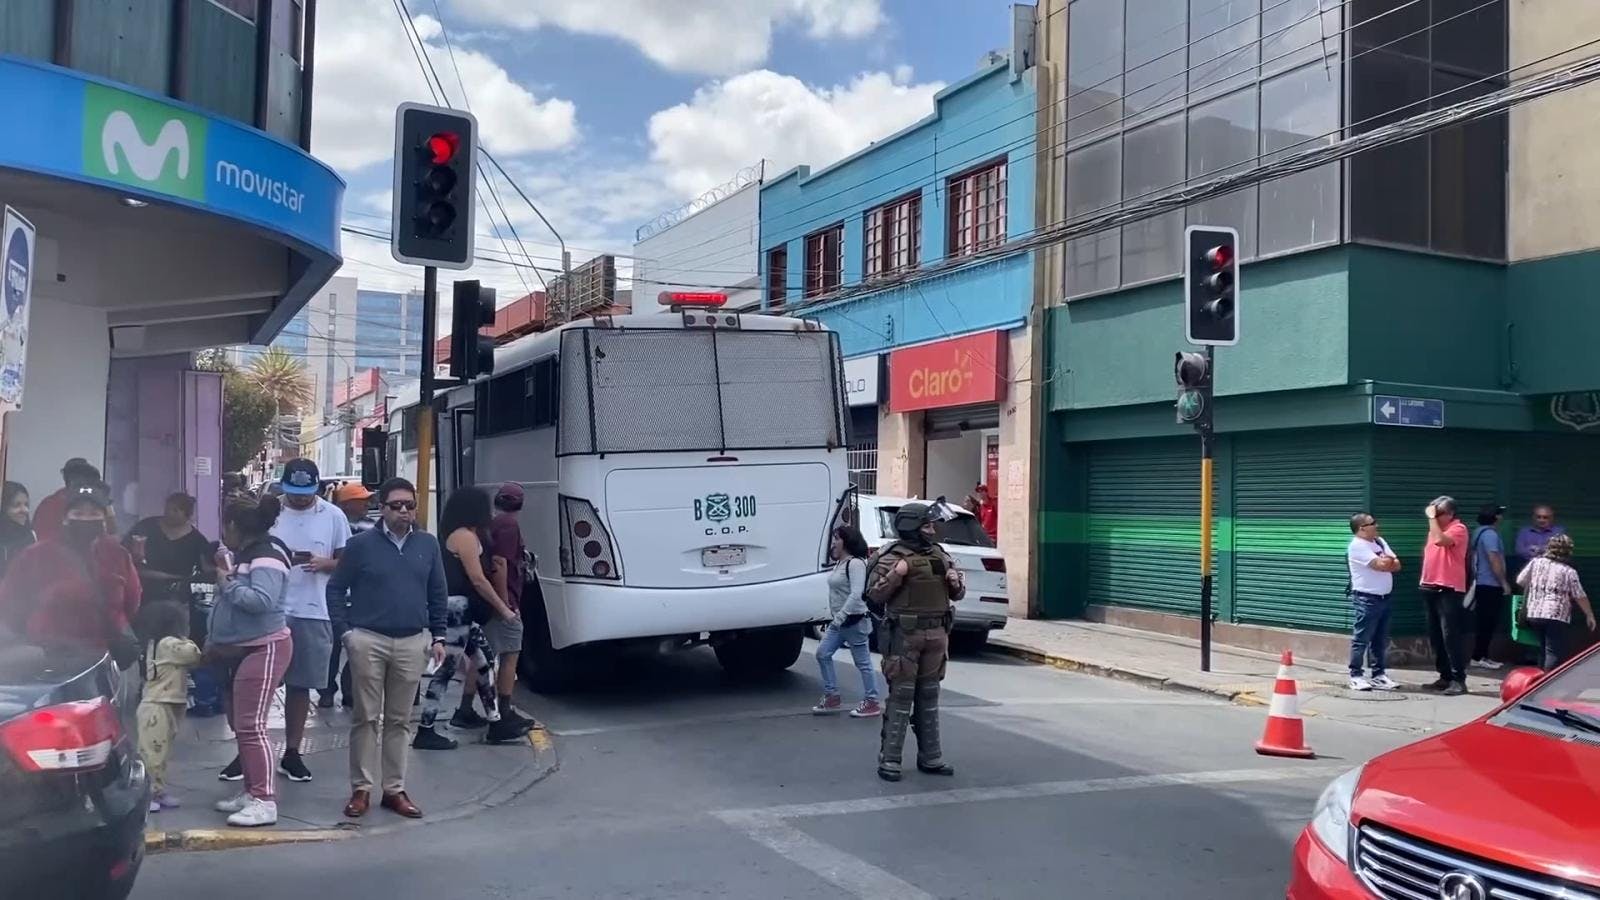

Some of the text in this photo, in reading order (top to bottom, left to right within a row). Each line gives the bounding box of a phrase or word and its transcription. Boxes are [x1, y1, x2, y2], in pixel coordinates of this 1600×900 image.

[216, 160, 304, 213] movistar
[909, 368, 962, 399] Claro
[694, 495, 756, 521] B 300
